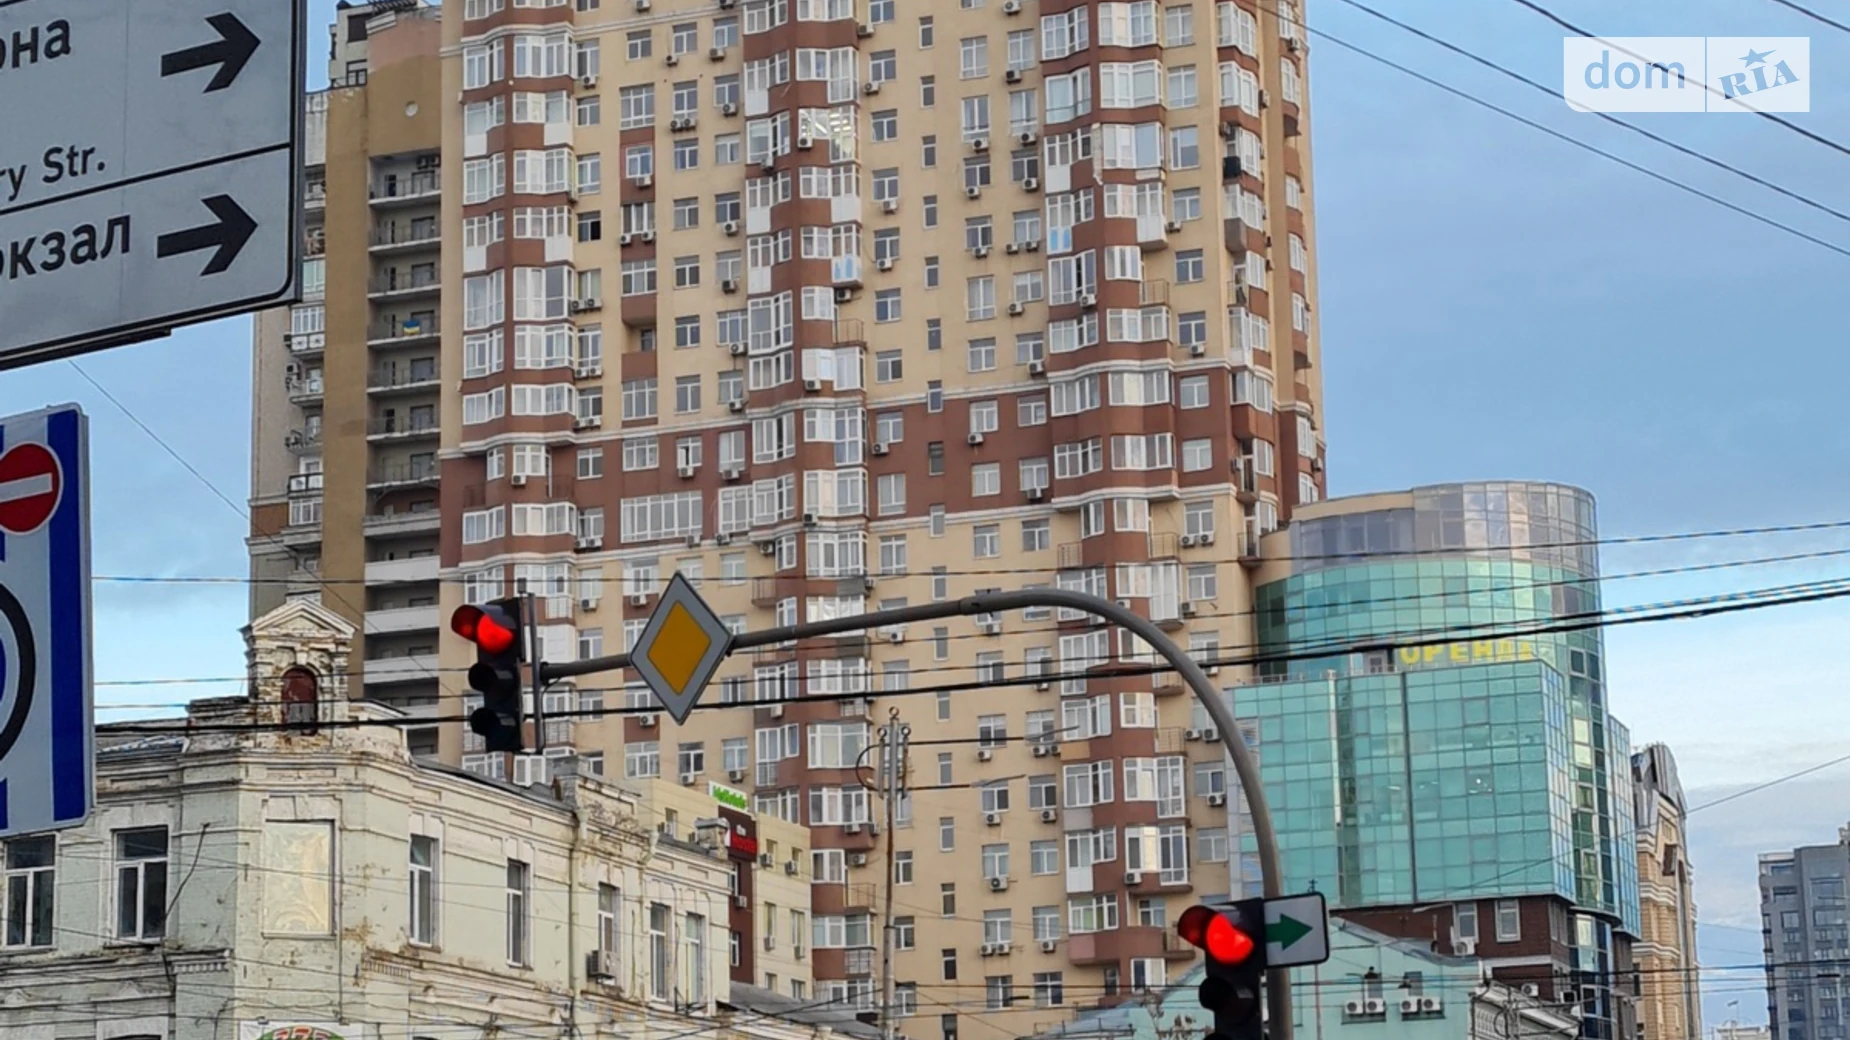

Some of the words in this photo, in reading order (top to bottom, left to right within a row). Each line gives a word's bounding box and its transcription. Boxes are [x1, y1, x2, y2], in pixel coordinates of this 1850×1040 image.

[0, 19, 71, 69] на
[42, 145, 105, 183] Str.
[0, 215, 130, 280] кзал
